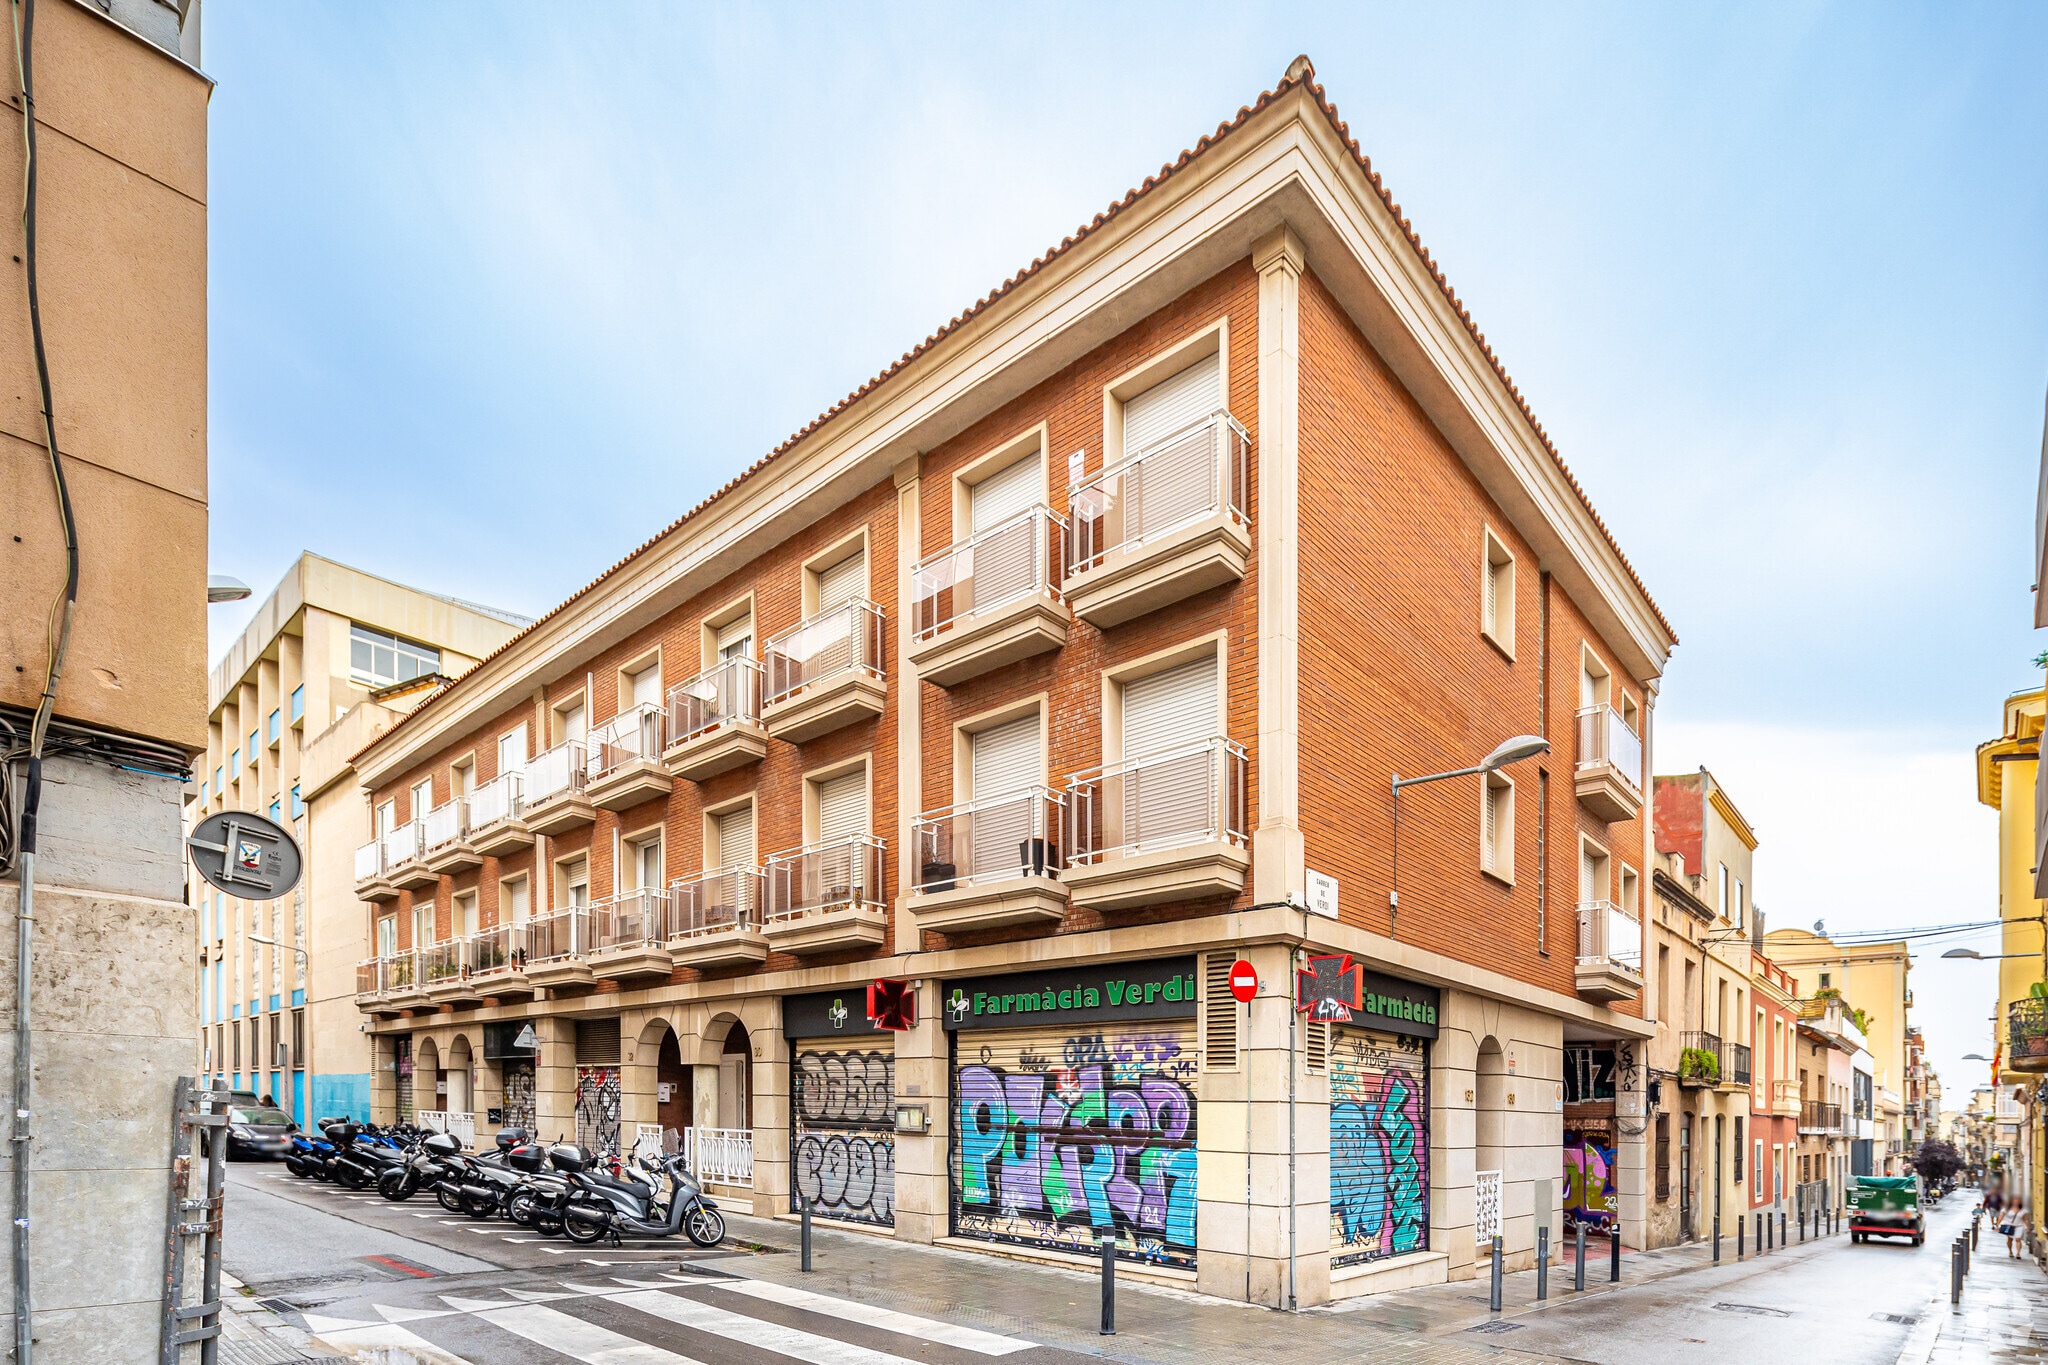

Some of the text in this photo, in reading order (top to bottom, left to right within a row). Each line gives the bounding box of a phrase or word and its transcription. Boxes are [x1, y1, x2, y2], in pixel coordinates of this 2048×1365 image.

[1317, 899, 1329, 910] VERDI
[973, 974, 1195, 1015] Farmàcia Verdi
